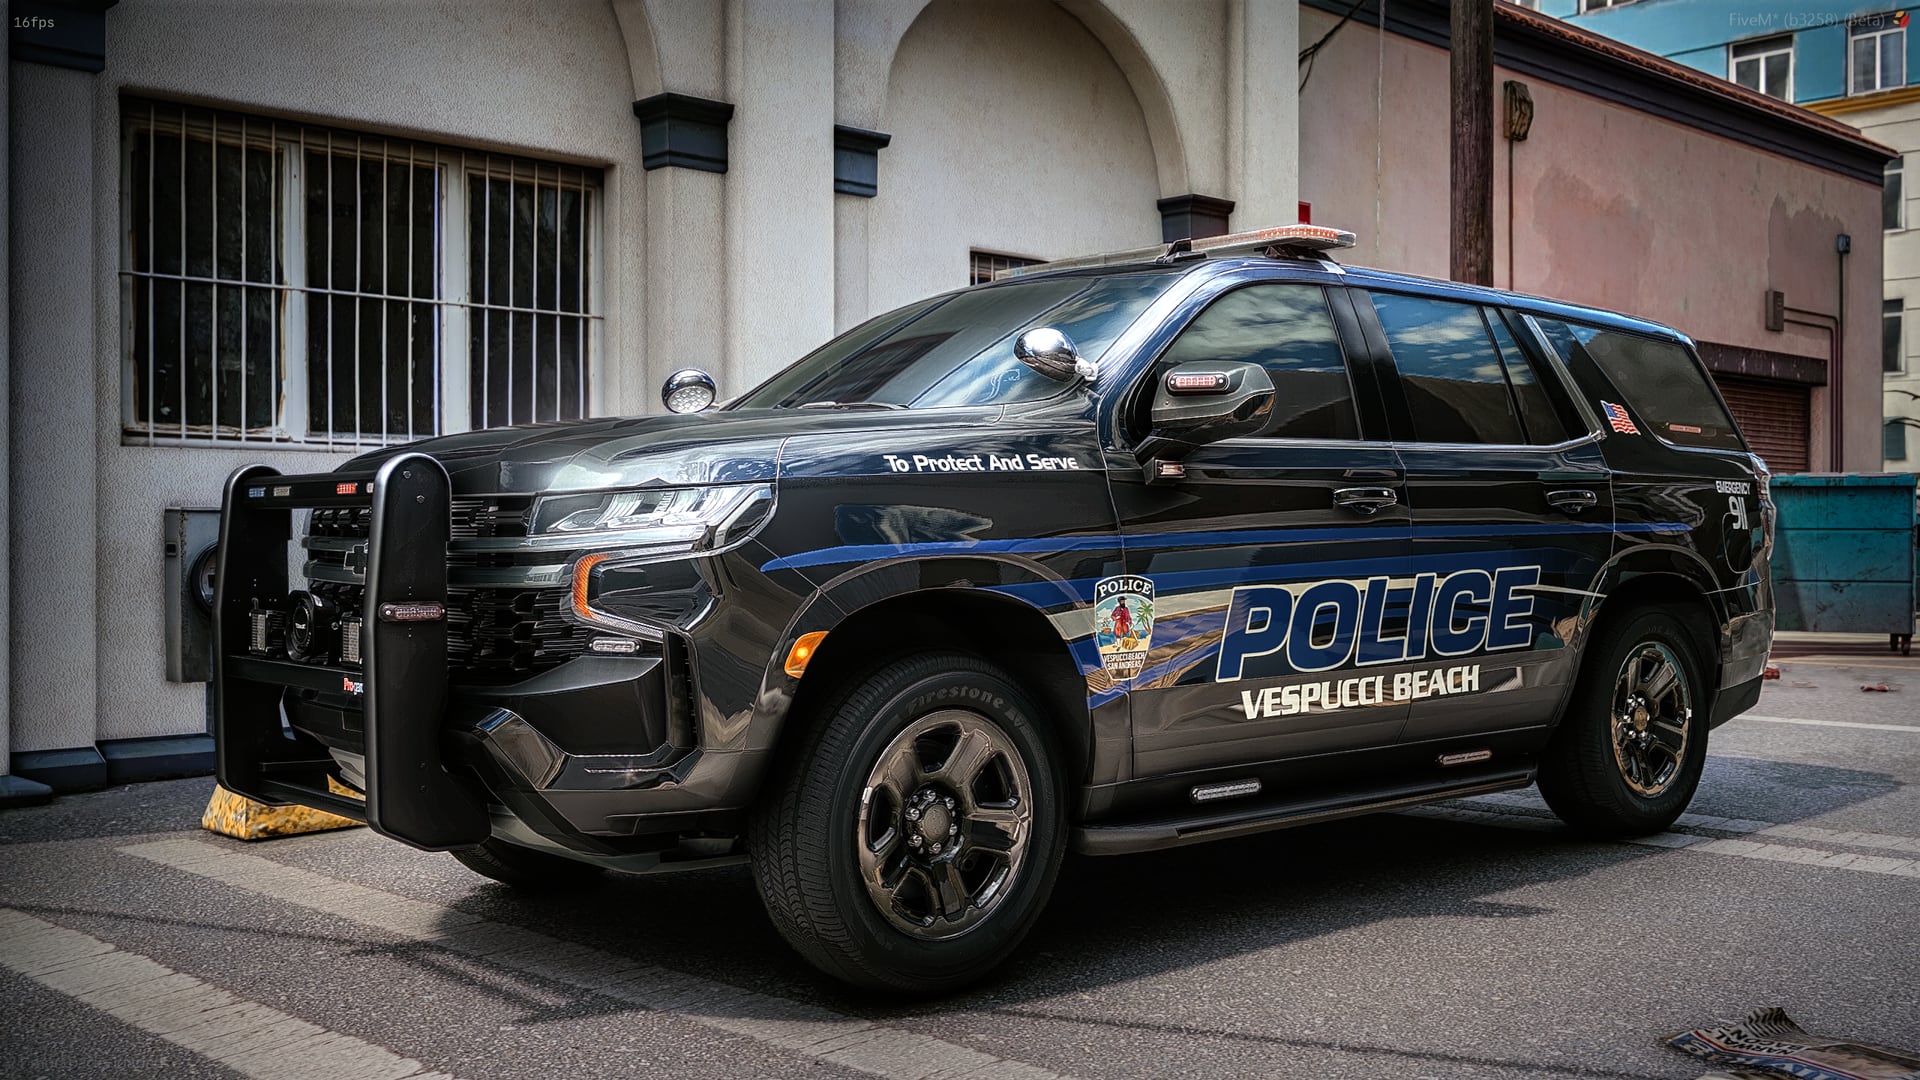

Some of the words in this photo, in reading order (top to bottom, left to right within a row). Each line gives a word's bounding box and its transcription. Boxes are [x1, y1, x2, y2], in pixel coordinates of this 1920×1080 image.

[883, 455, 910, 472] To
[913, 454, 985, 472] Protect
[989, 453, 1025, 471] And
[1026, 453, 1080, 470] Serve
[1715, 480, 1751, 495] EMERGENCY
[1098, 579, 1152, 597] POLICE
[1215, 565, 1541, 683] POLICE
[905, 686, 1004, 717] Firestone
[1241, 675, 1385, 720] VESPUCCI
[1393, 664, 1481, 702] BEACH
